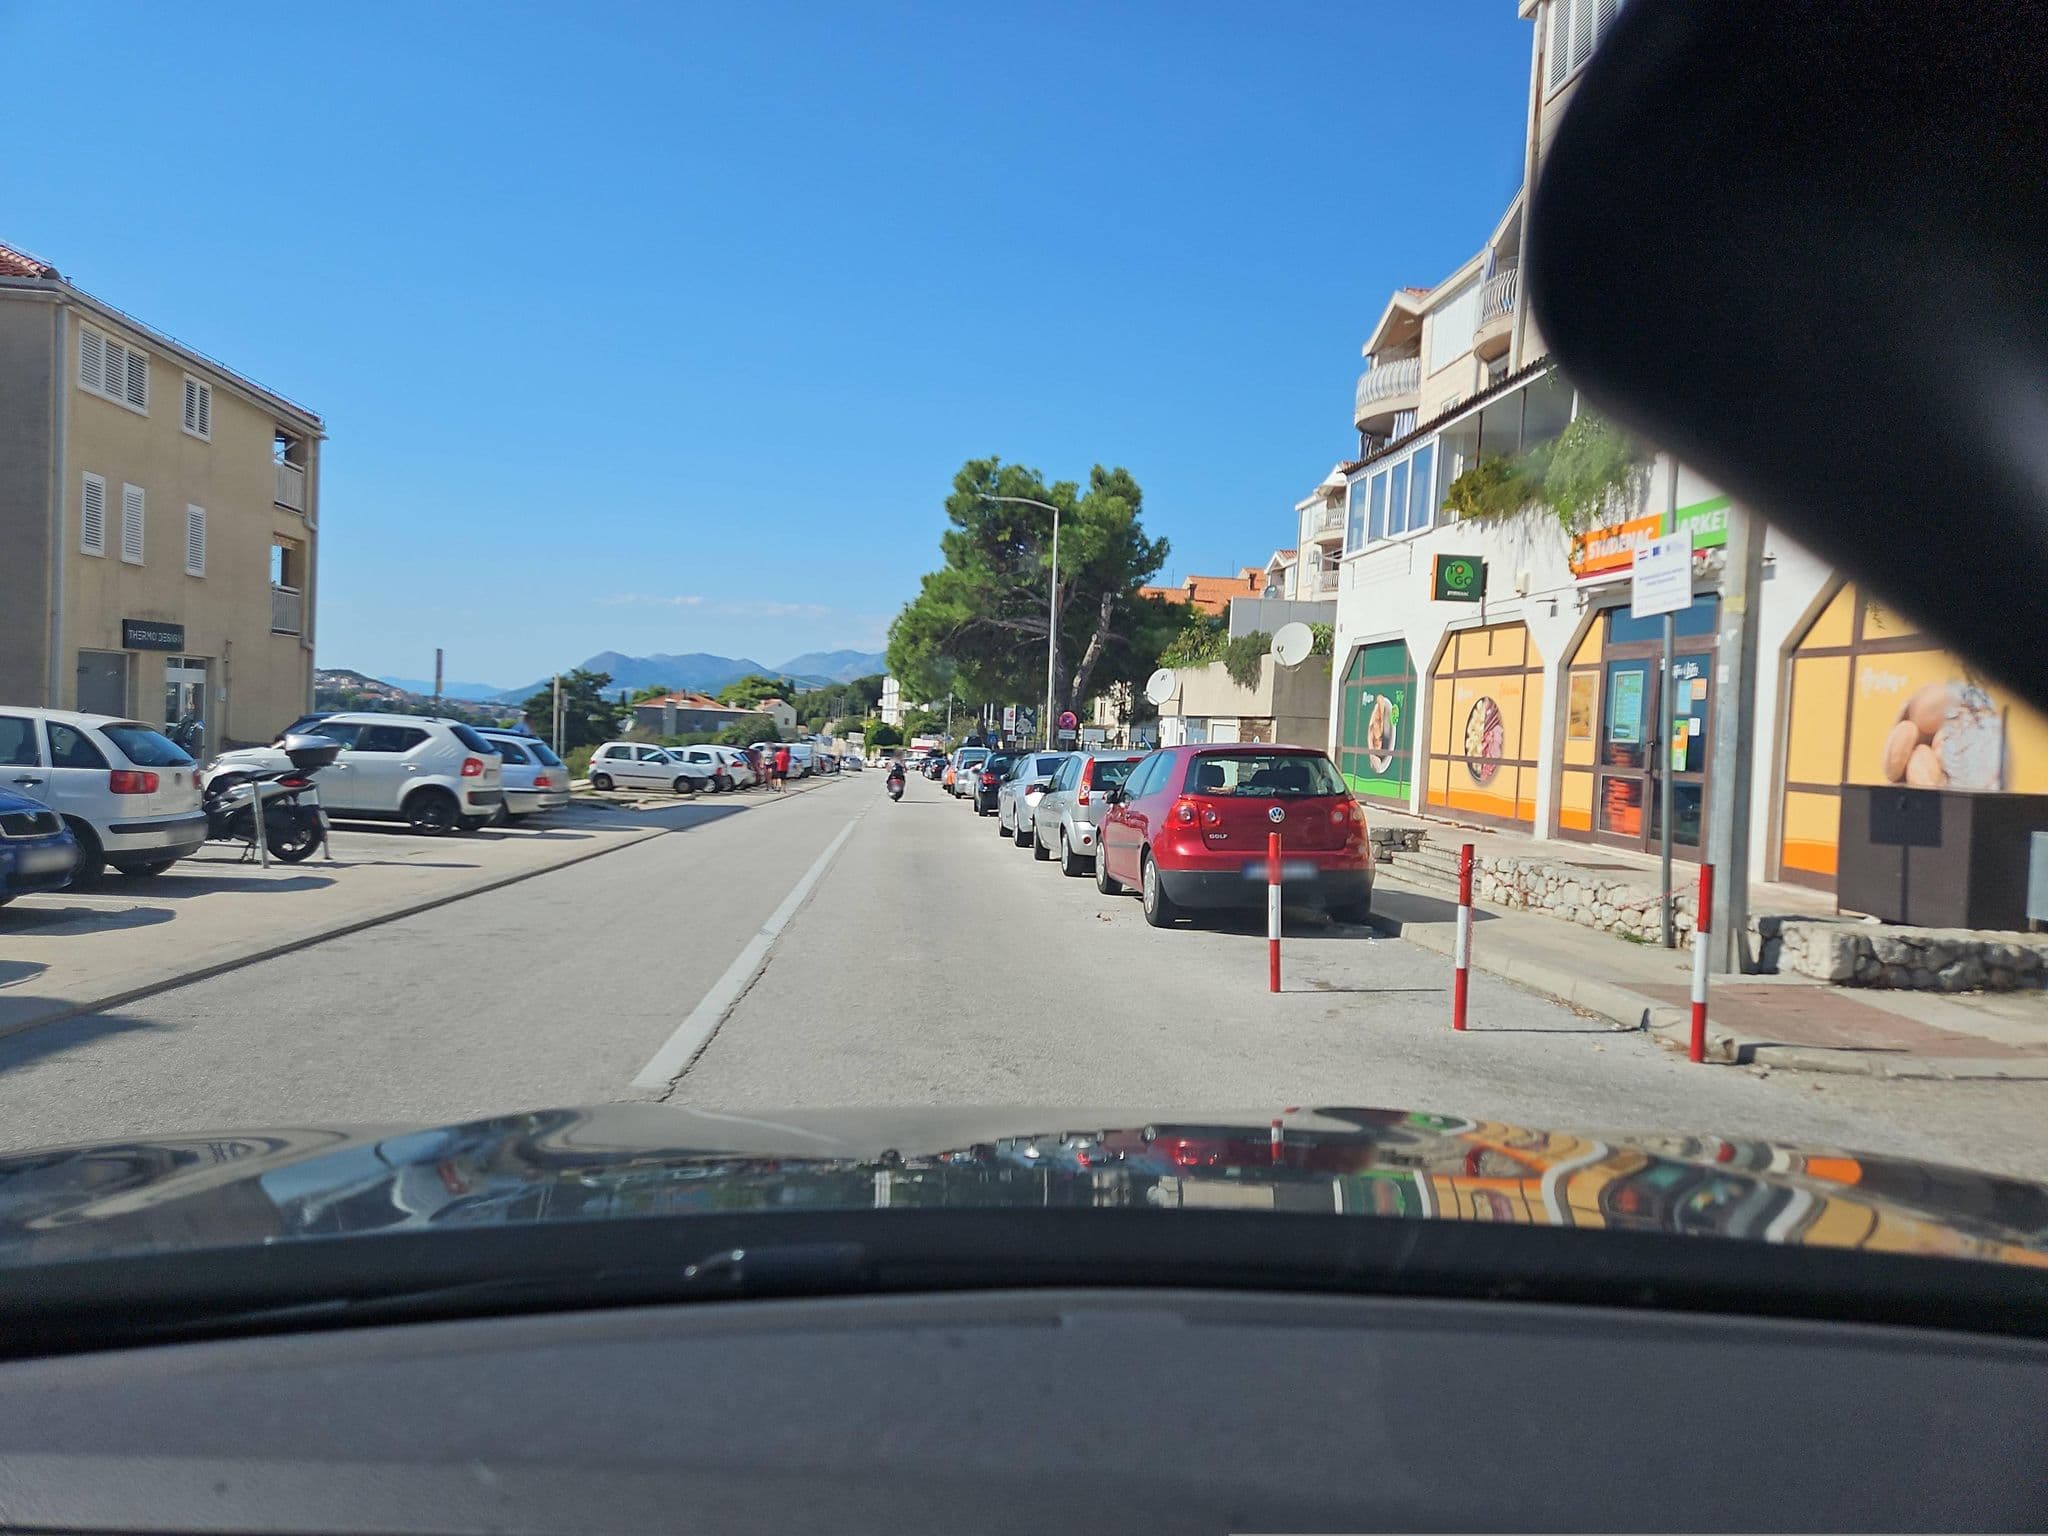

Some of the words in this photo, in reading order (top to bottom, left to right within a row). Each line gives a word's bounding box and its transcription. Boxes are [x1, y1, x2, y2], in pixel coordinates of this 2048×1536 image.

[1454, 575, 1473, 586] GO
[128, 629, 157, 641] THERMO
[158, 632, 184, 645] DESIGN
